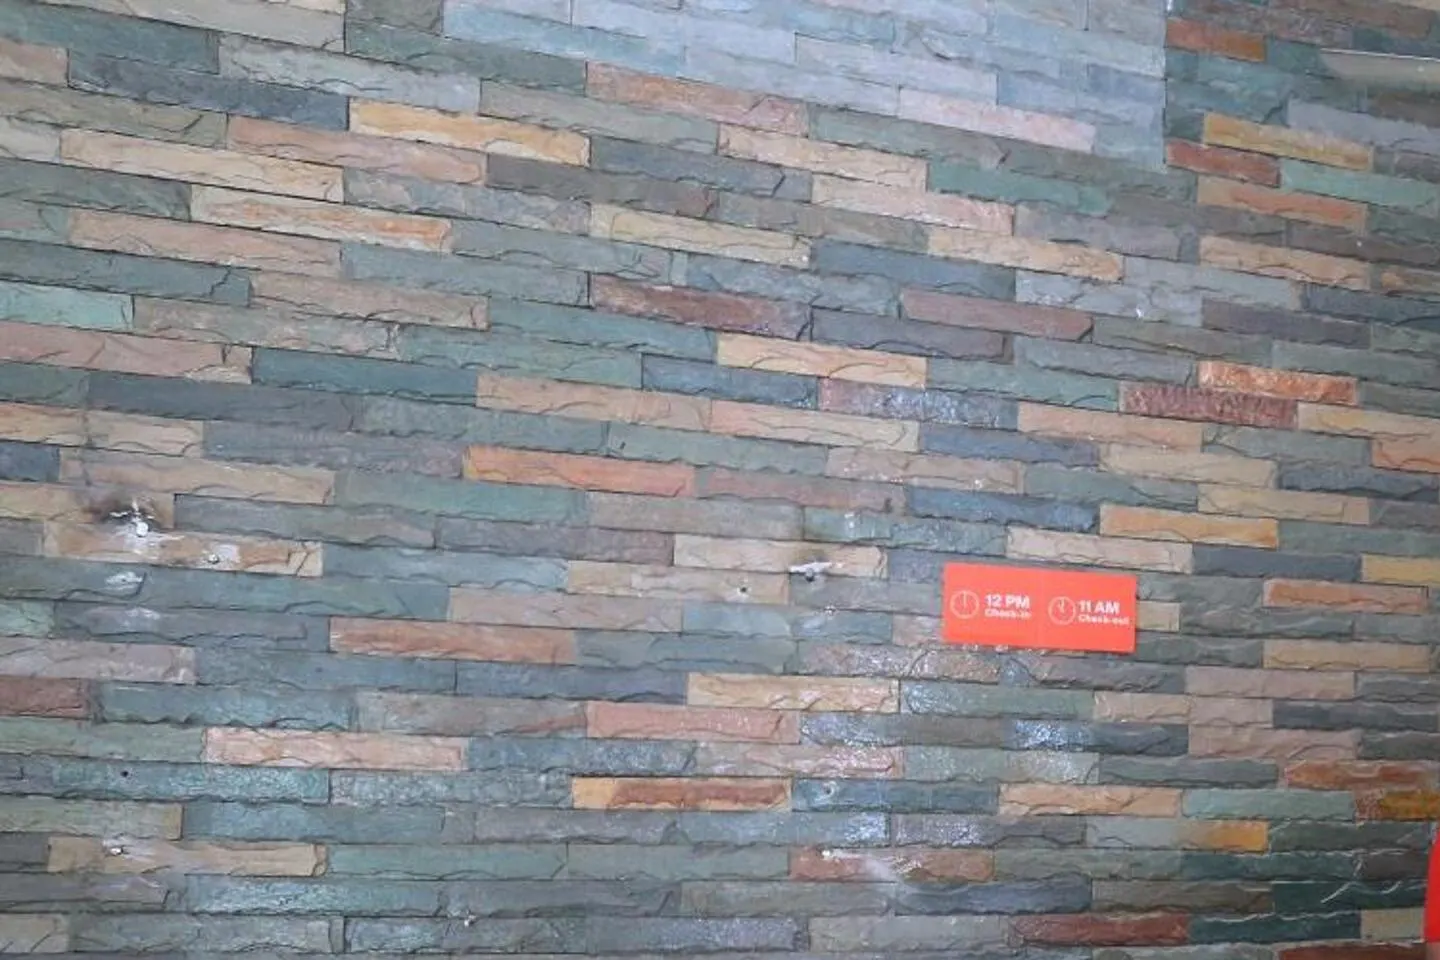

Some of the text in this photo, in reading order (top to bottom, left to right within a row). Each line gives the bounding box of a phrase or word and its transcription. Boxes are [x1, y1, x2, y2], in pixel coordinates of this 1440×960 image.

[984, 594, 1030, 609] 12 PM
[1078, 600, 1120, 614] 11 AM
